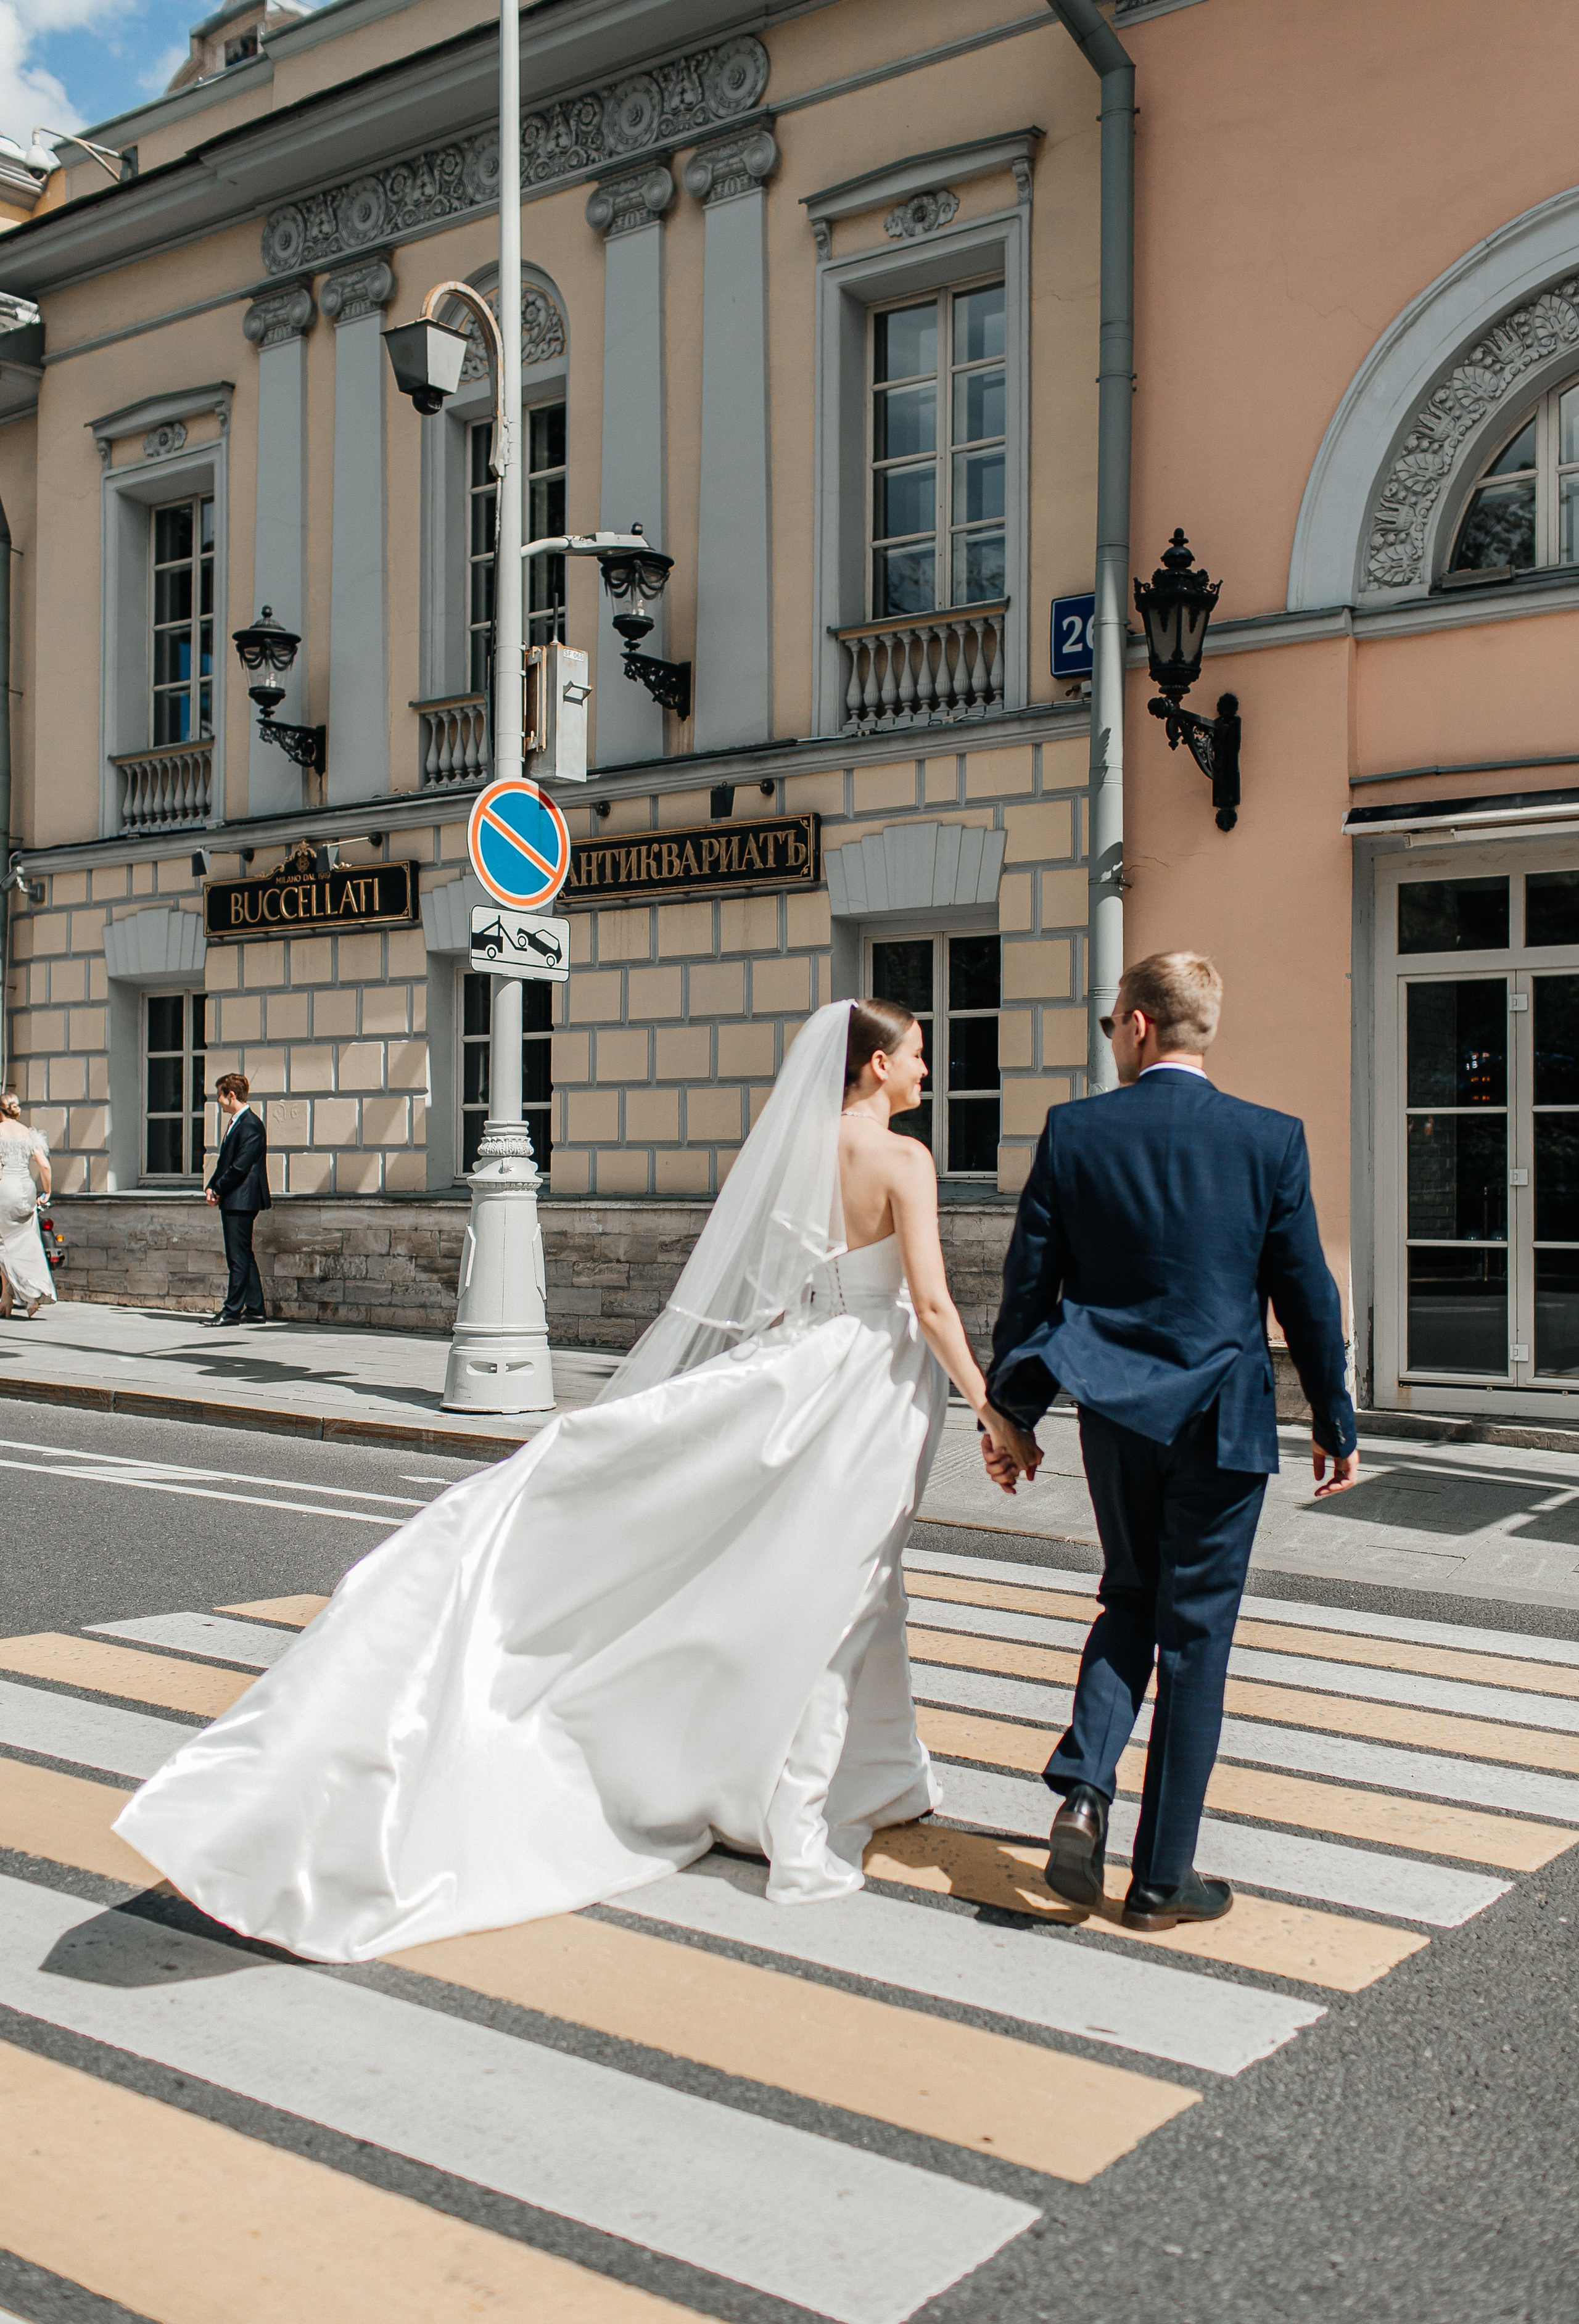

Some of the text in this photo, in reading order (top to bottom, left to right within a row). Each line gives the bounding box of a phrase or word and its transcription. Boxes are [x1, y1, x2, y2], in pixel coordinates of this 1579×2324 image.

[275, 871, 331, 884] MILANO DAL 1919
[231, 878, 379, 924] BUCCELLATI
